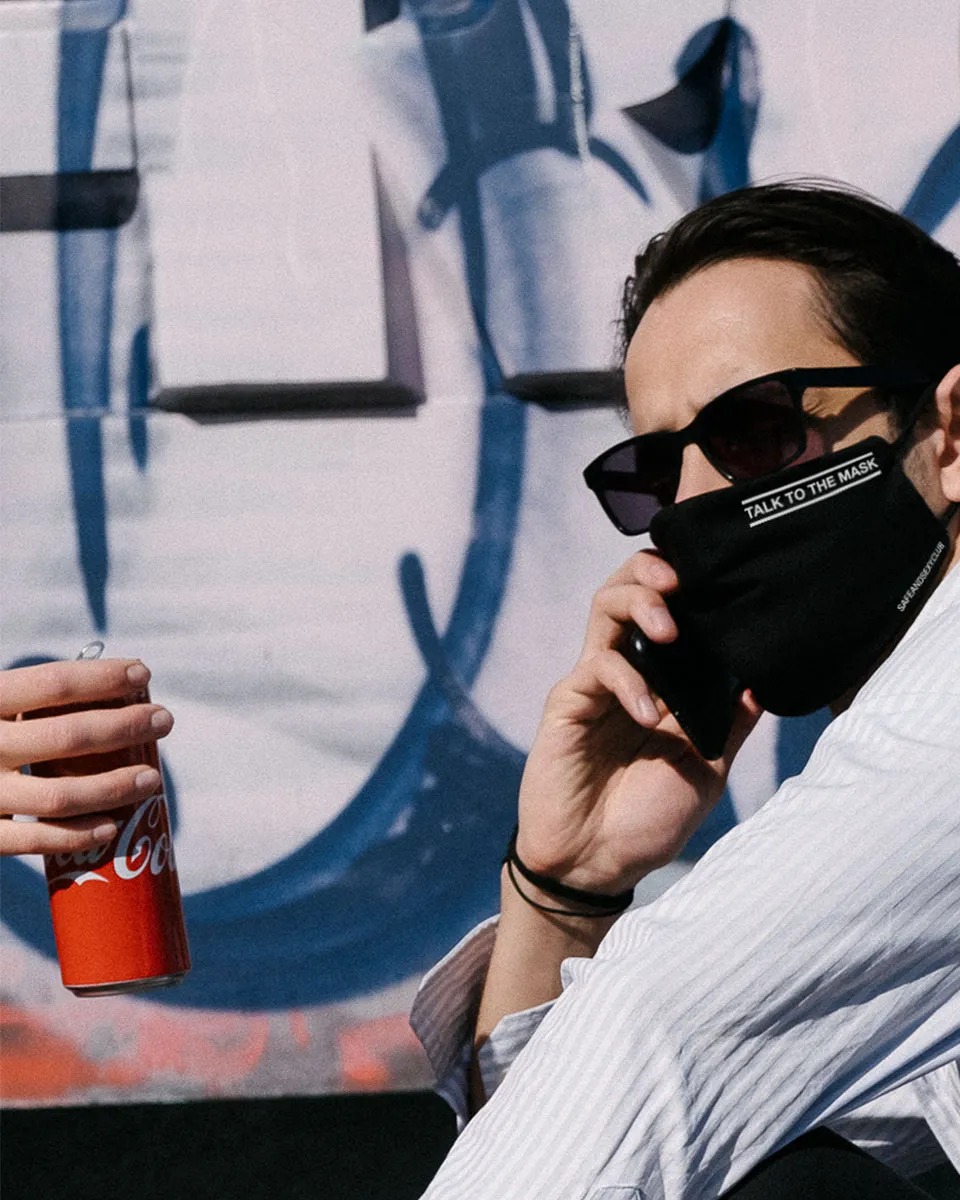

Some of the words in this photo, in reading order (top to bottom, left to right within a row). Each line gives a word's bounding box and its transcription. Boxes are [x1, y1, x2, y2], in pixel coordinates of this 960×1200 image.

[744, 496, 784, 520] TALK
[785, 487, 806, 505] TO
[807, 475, 837, 496] THE
[838, 457, 880, 484] MASK
[897, 541, 946, 613] SAFEANDSEXYCLUB
